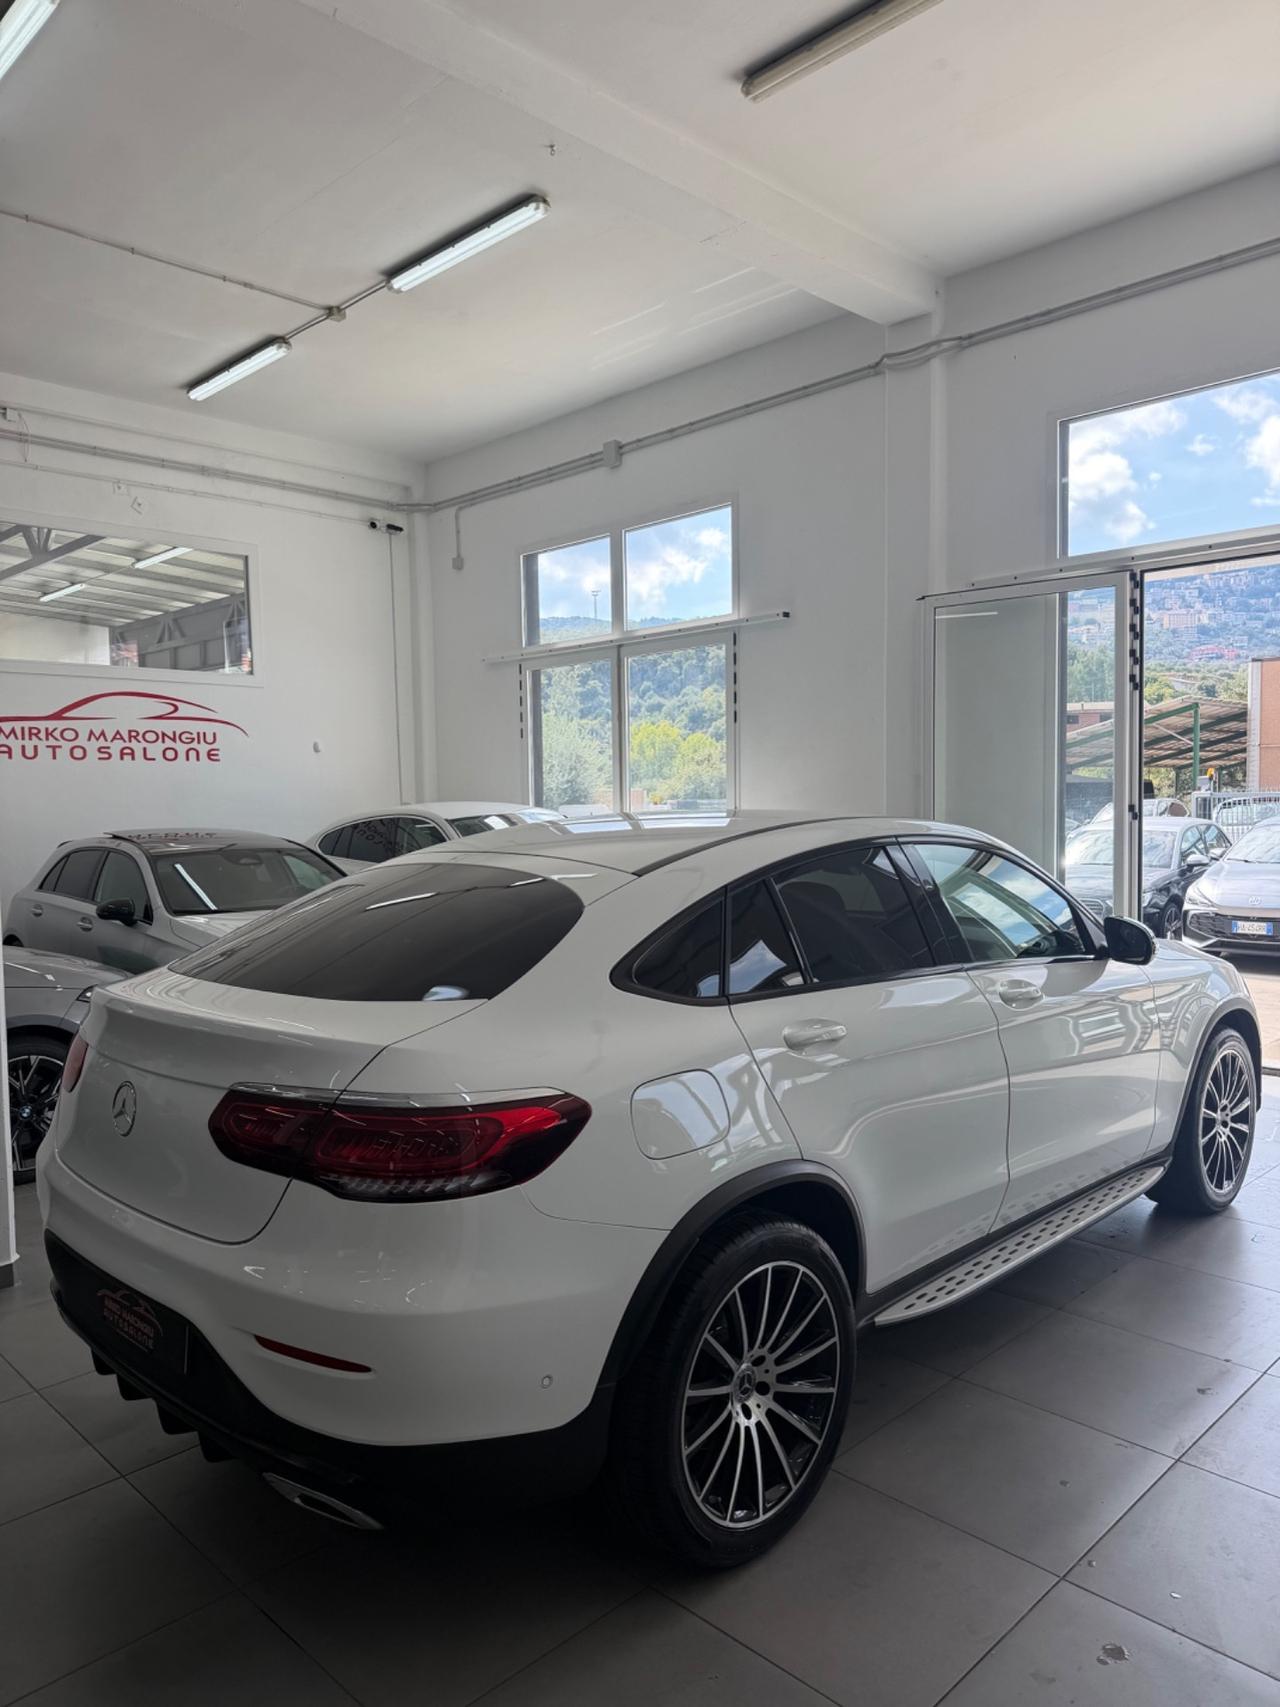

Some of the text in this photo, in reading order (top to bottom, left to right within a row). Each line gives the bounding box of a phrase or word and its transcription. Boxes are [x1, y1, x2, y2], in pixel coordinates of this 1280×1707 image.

[0, 726, 217, 745] MIRKO MARONGIU
[0, 744, 221, 762] AUTOSALONE
